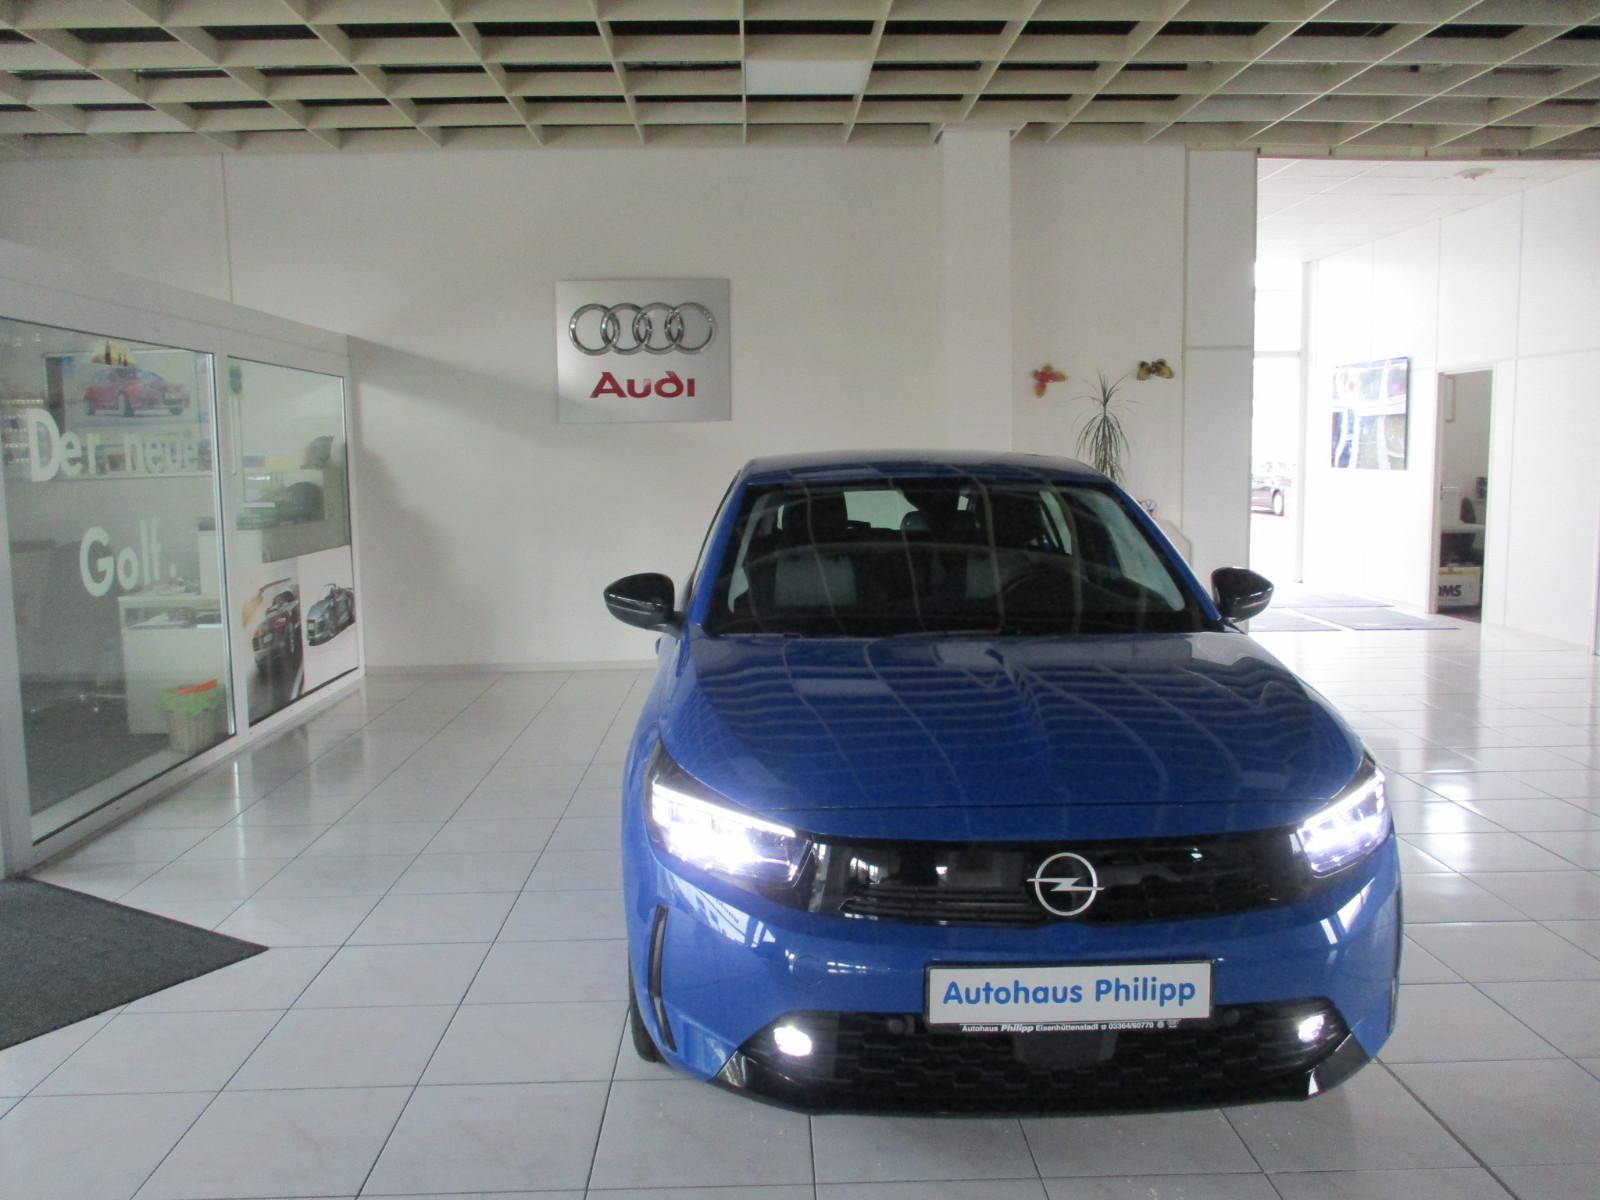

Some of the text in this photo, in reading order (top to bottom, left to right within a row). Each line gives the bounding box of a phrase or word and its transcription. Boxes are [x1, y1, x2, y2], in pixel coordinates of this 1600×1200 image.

[590, 370, 696, 398] Audi
[26, 407, 103, 482] Der
[942, 976, 1196, 1007] Autohaus Philipp
[961, 1024, 999, 1033] Autohaus
[1000, 1023, 1034, 1033] Philipp
[1035, 1022, 1099, 1032] Eisenhüttenstadt
